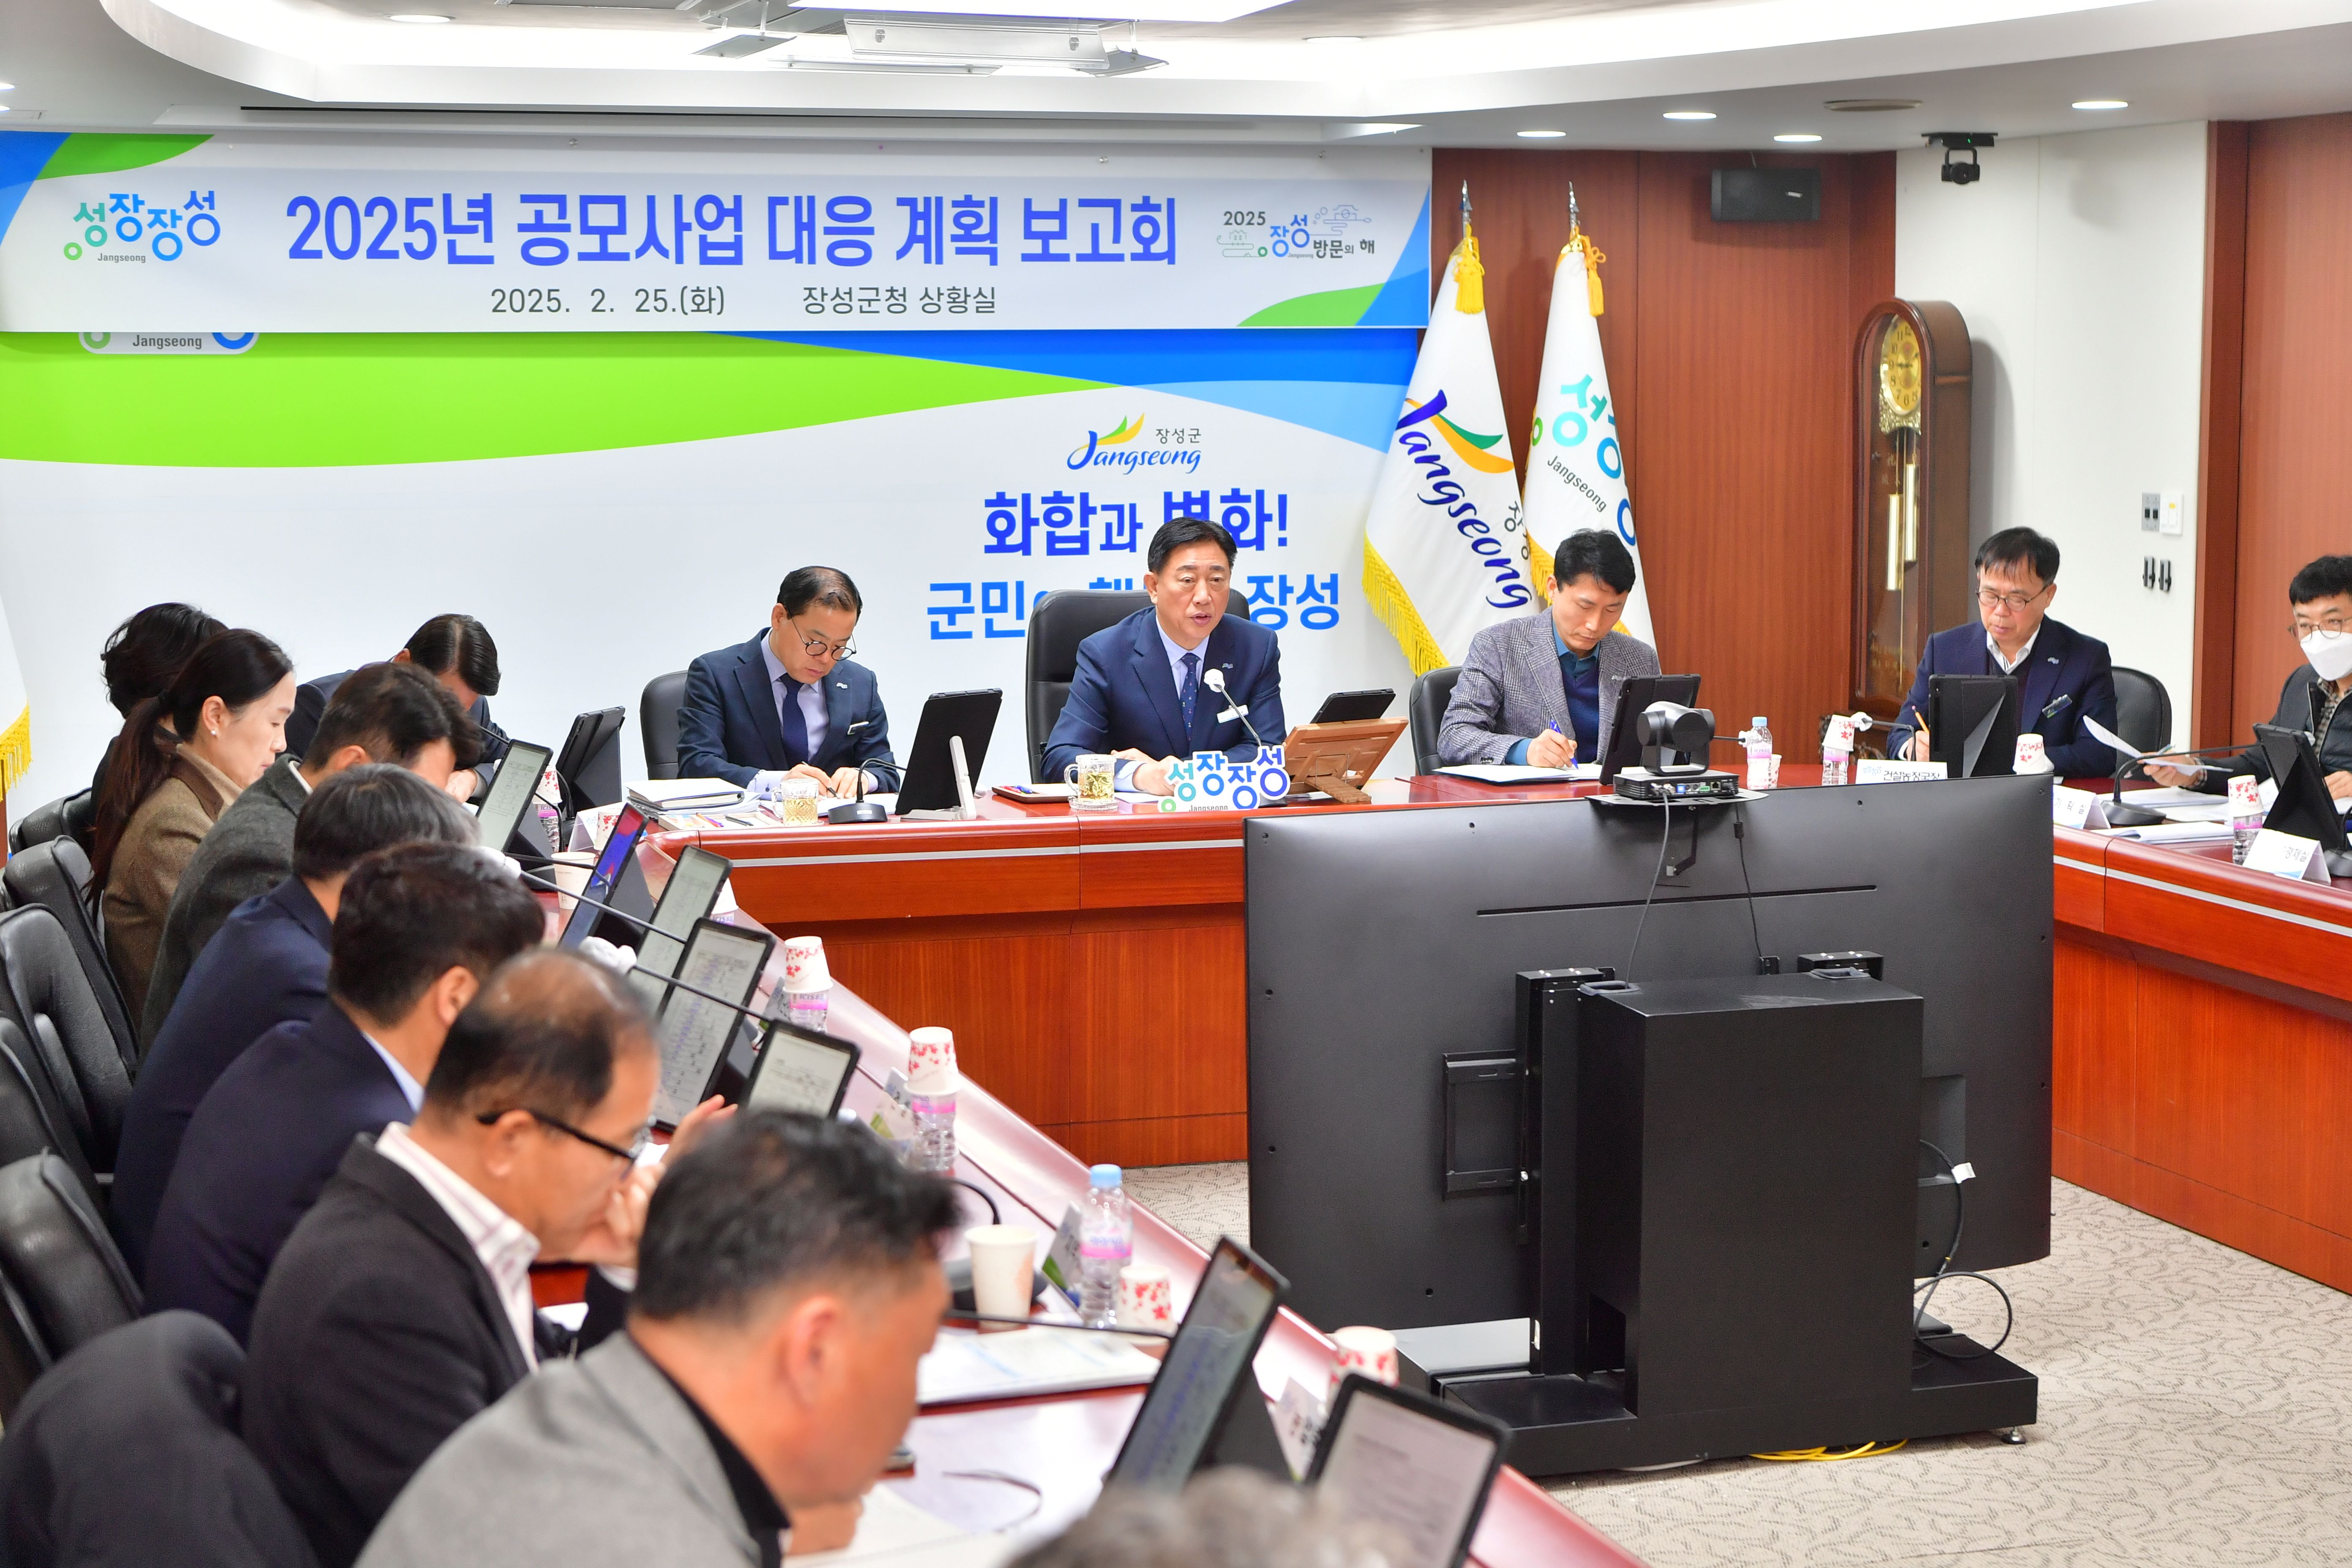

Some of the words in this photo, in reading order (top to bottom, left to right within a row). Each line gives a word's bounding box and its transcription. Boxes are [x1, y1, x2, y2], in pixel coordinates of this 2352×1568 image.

[73, 191, 221, 262] 성장장성
[287, 193, 495, 265] 2025년
[517, 194, 743, 266] 공모사업
[768, 195, 875, 267] 대응
[896, 194, 998, 266] 계획
[1021, 195, 1176, 265] 보고회
[1224, 211, 1266, 226] 2025
[1270, 215, 1310, 257] 장성
[1313, 240, 1354, 259] 방문의
[1359, 239, 1375, 254] 해
[98, 253, 146, 264] Jangseong
[491, 289, 570, 313] 2025.
[591, 288, 614, 313] 2.
[635, 286, 724, 316] 25.(화)
[803, 286, 907, 314] 장성군청
[920, 286, 995, 314] 상황실
[132, 334, 202, 350] Jangseong
[1067, 430, 1201, 475] Jangseong
[1155, 427, 1201, 444] 장성군
[1547, 455, 1607, 513] Jangseong
[984, 490, 1143, 556] 화합과
[927, 580, 1048, 640] 군민
[1247, 573, 1339, 631] 장성
[1168, 748, 1288, 810] 성장장성
